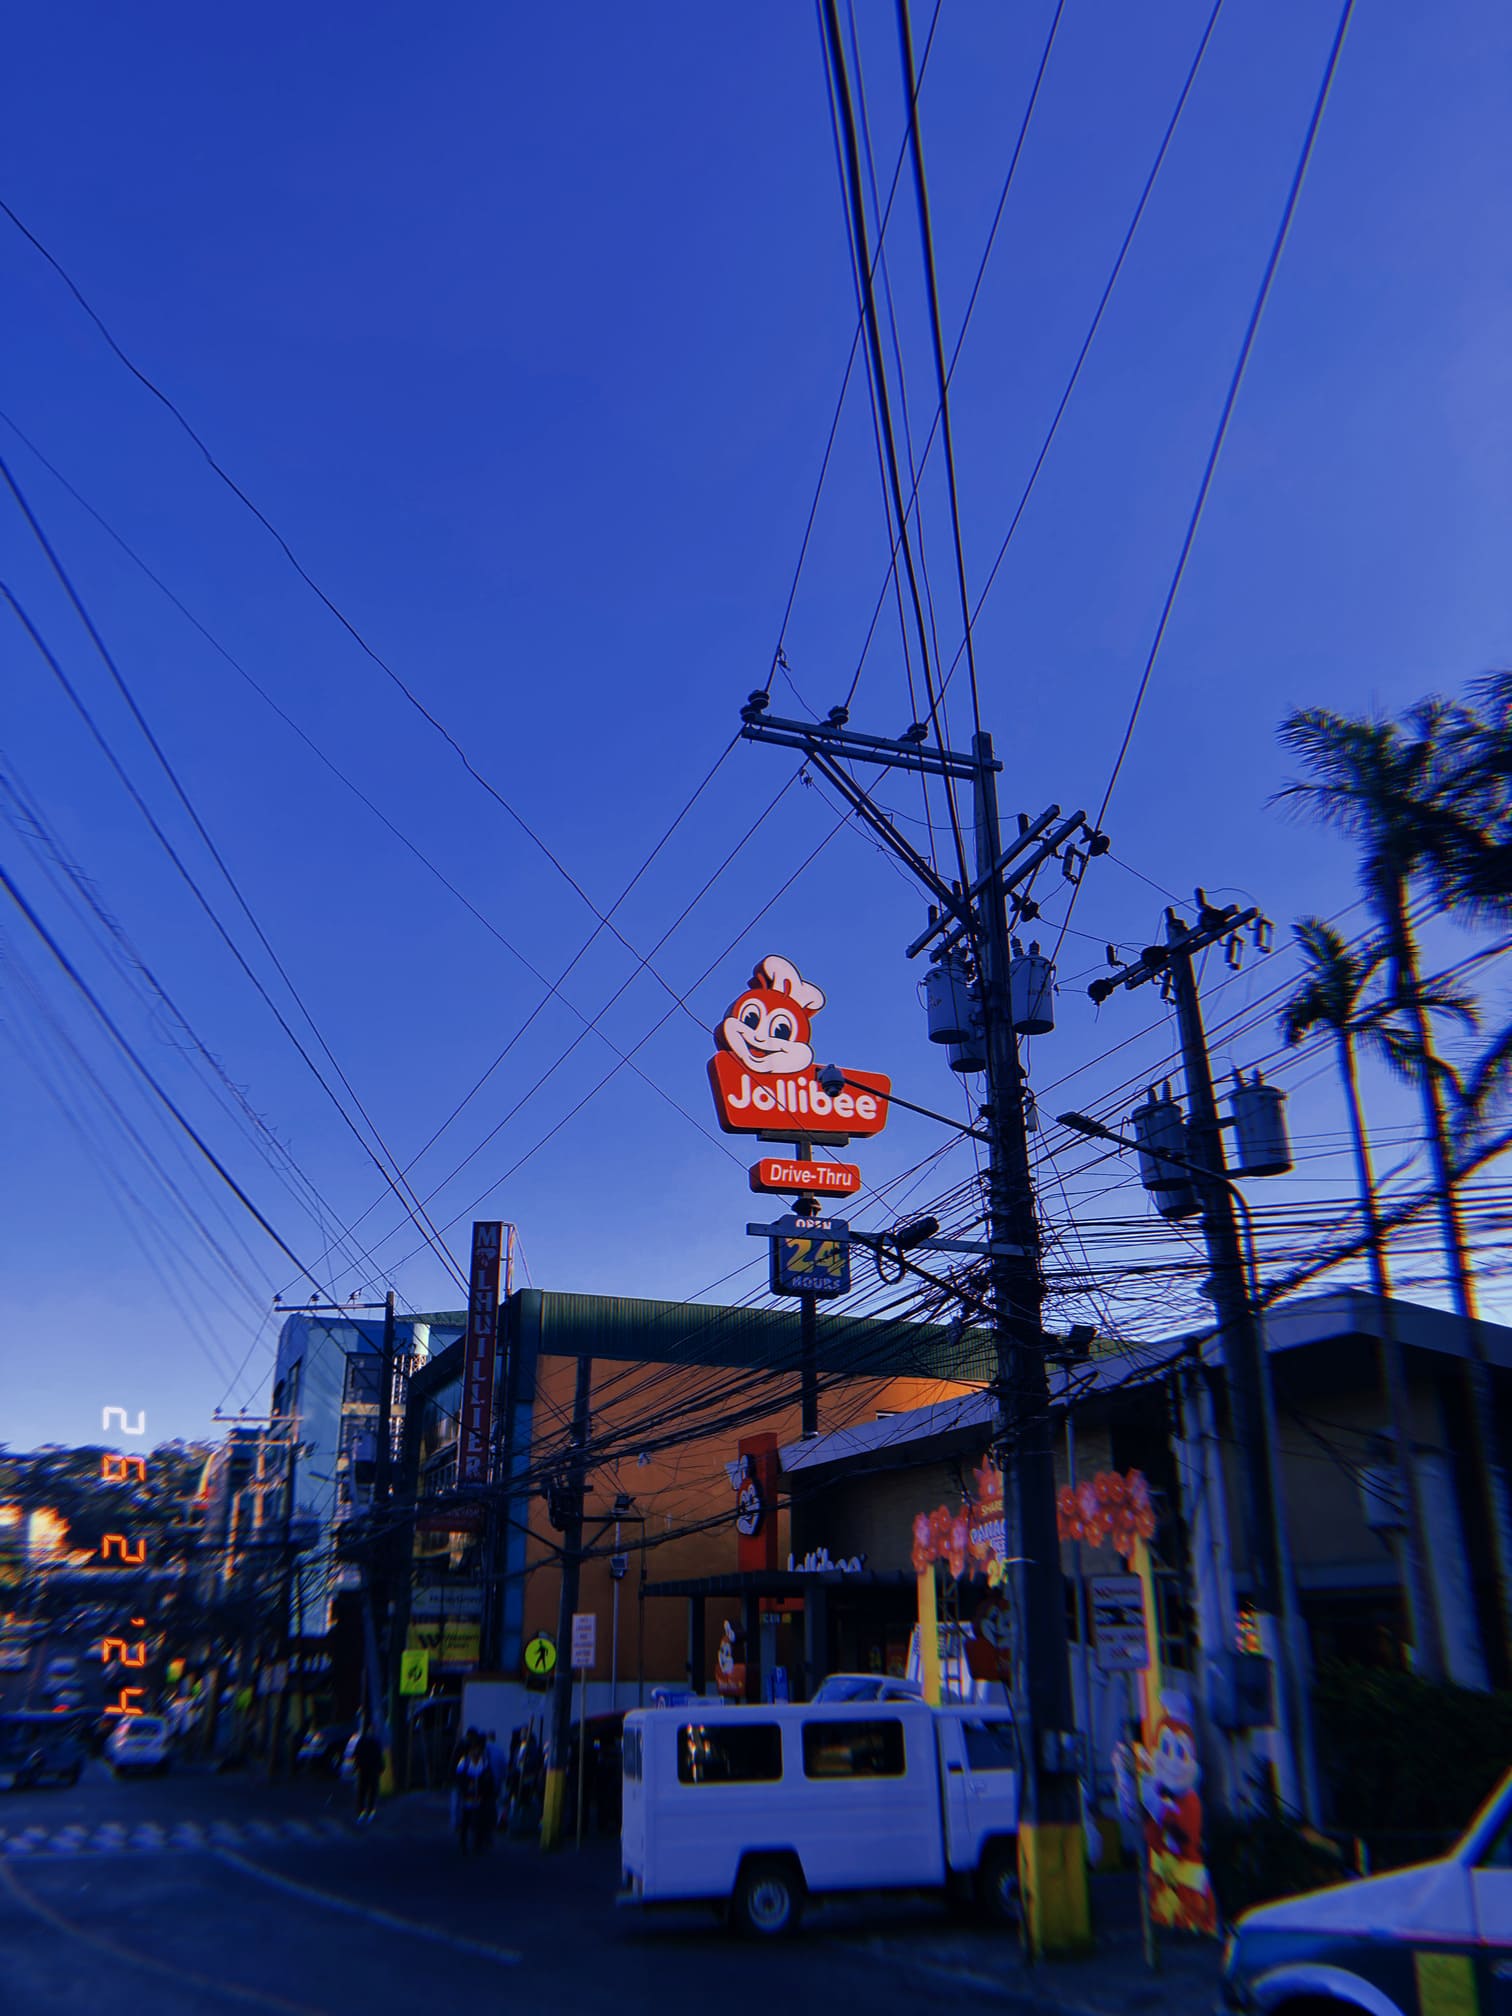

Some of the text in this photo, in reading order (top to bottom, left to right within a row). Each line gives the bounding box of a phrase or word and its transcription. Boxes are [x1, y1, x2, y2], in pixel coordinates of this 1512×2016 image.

[727, 1073, 877, 1120] Jollibee
[770, 1164, 852, 1186] Drive-Thru
[785, 1238, 846, 1277] 24
[792, 1276, 841, 1290] HOURS
